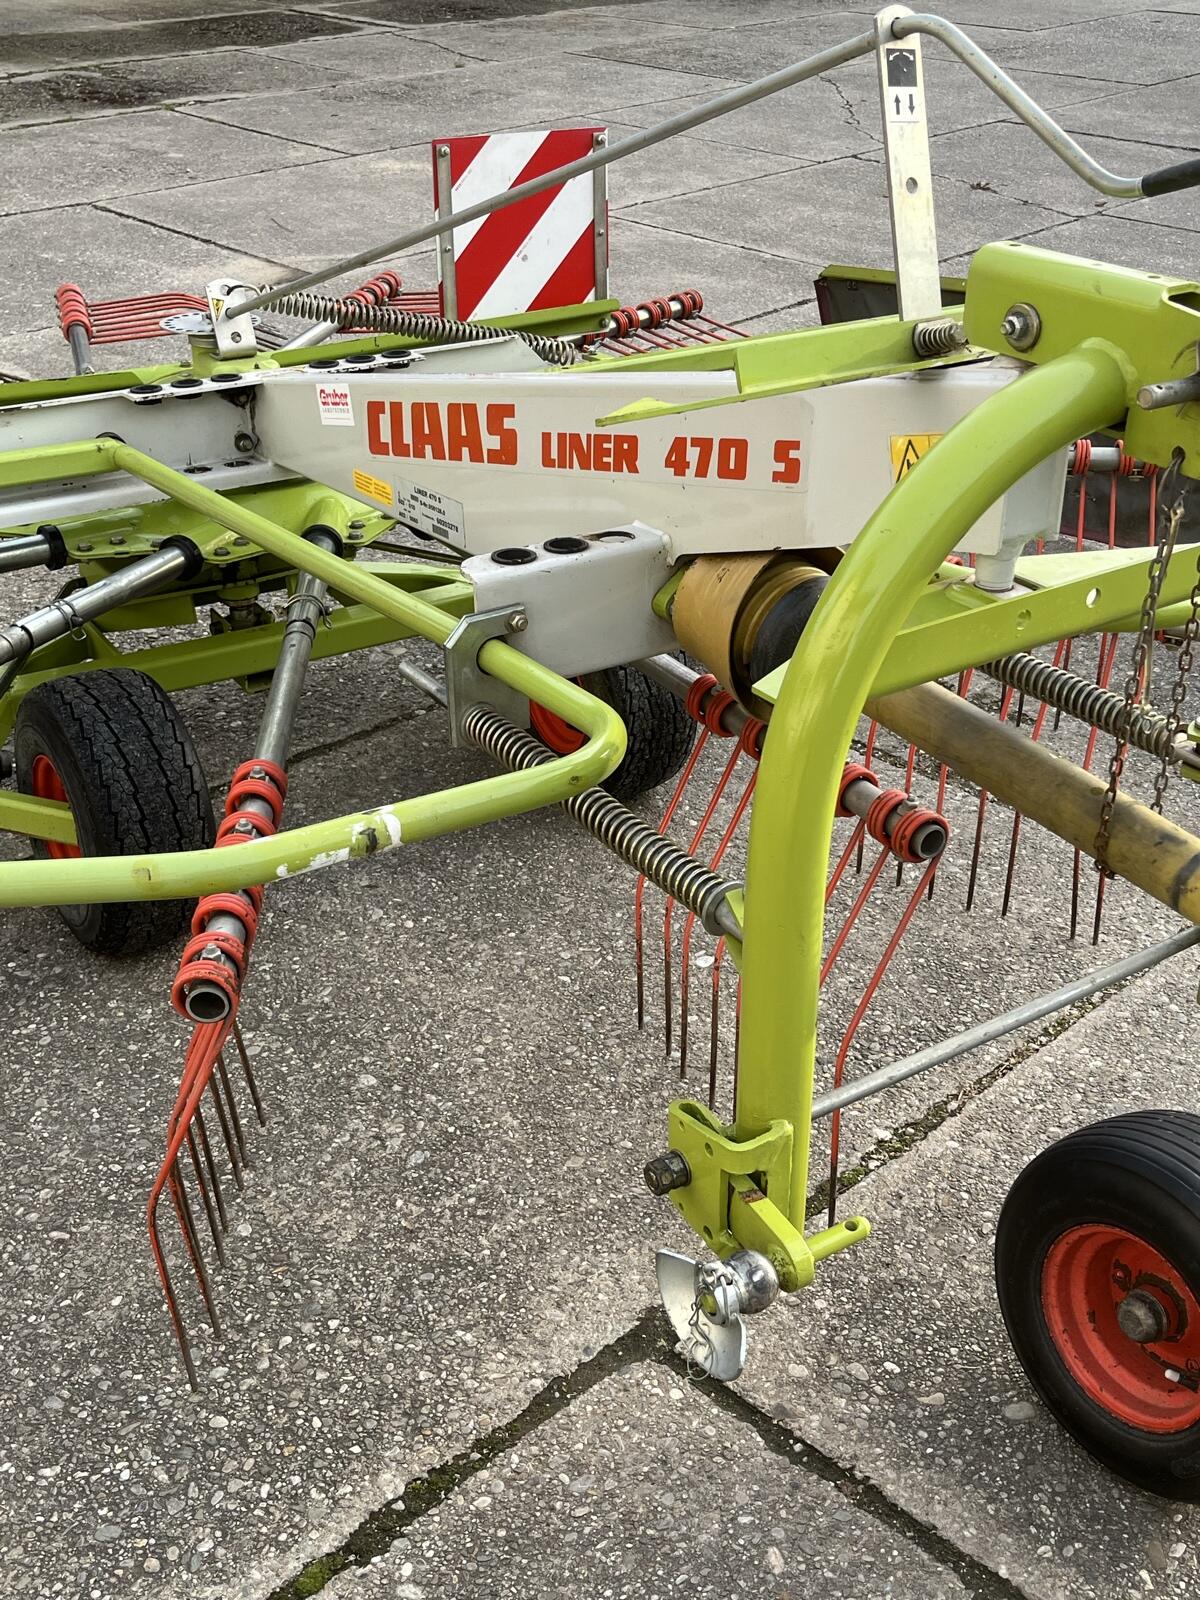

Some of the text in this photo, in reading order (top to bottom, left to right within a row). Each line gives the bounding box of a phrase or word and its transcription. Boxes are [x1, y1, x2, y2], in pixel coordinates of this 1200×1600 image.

[367, 400, 801, 484] CLAAS LINER 470 S
[413, 486, 428, 498] LINER
